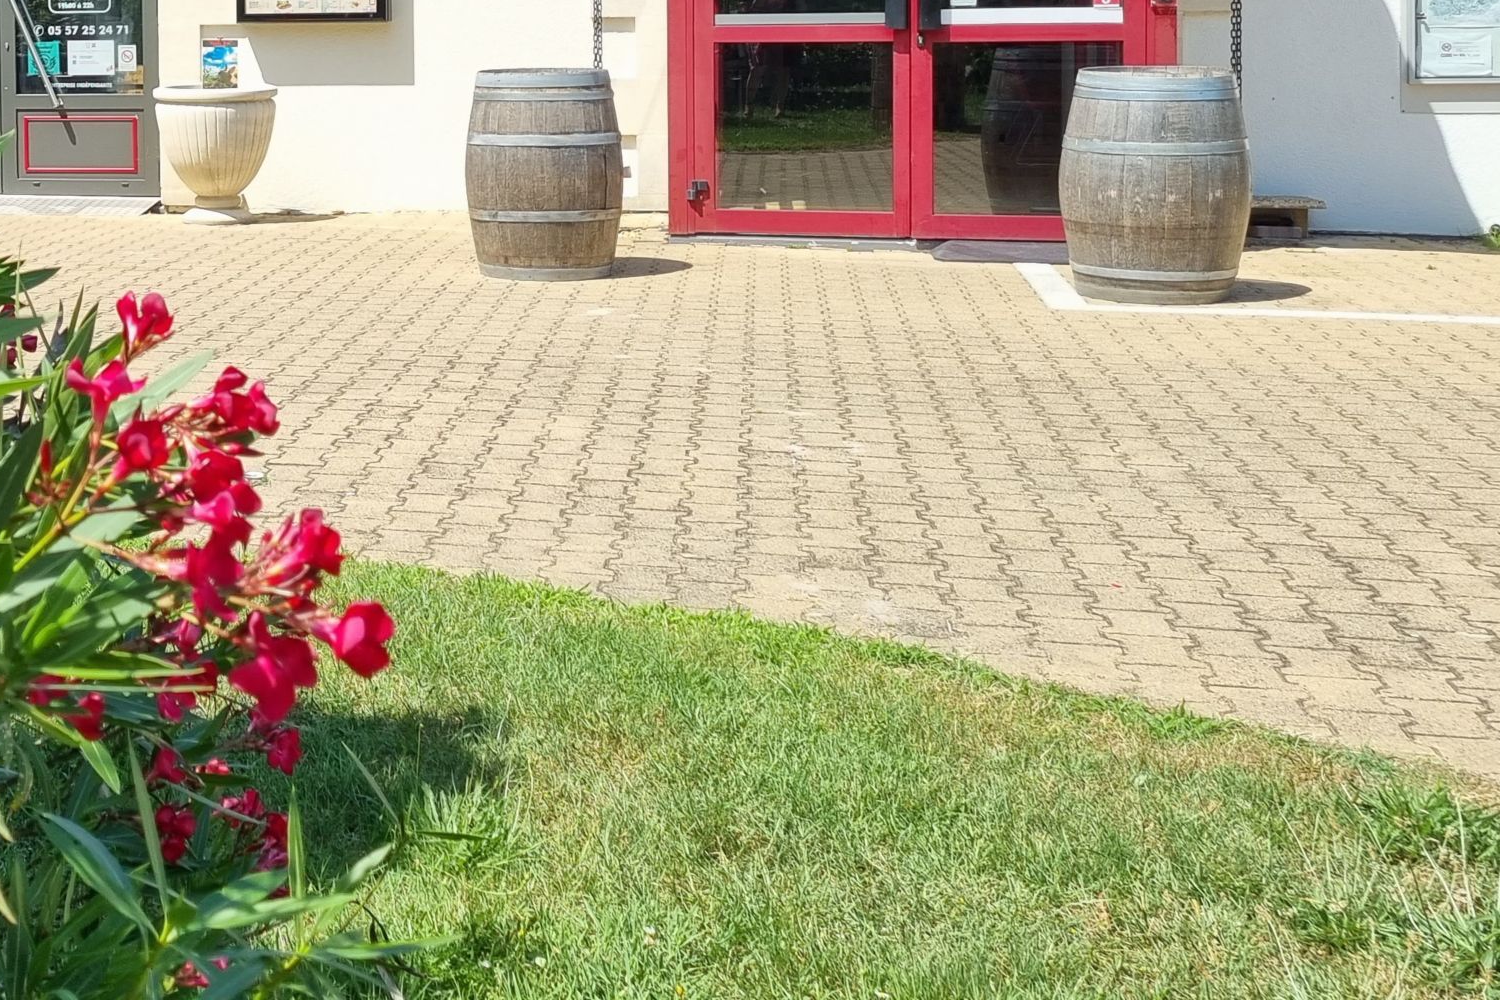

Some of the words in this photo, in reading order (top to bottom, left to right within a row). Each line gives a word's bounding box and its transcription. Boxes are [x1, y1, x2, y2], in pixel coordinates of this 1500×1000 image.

[47, 25, 61, 35] 05
[64, 25, 78, 35] 57
[81, 25, 95, 35] 25
[99, 25, 113, 35] 24
[116, 25, 129, 35] 71
